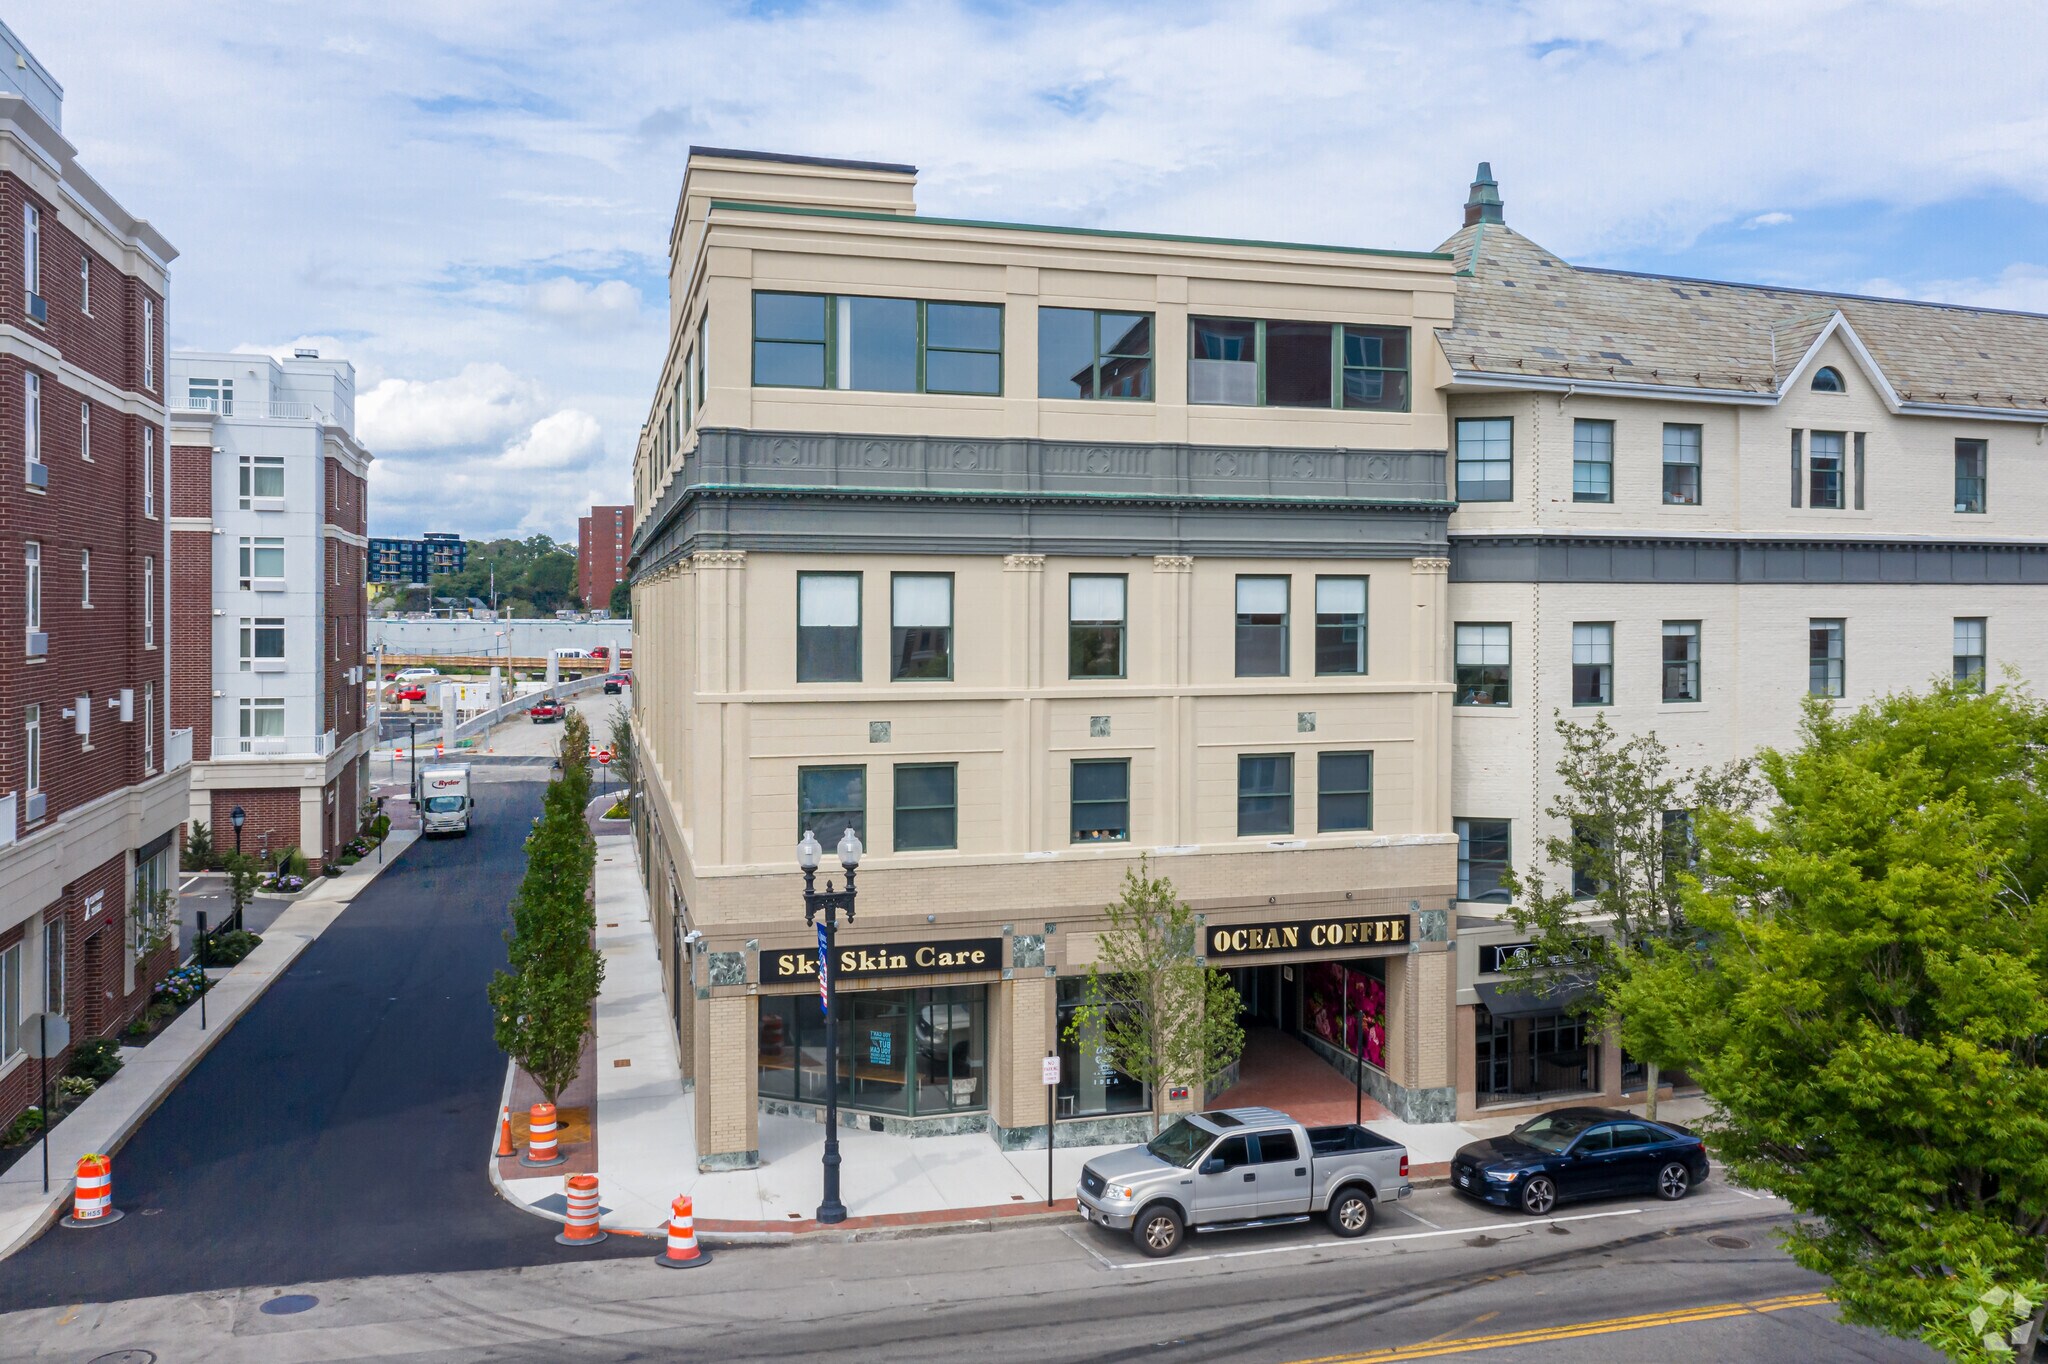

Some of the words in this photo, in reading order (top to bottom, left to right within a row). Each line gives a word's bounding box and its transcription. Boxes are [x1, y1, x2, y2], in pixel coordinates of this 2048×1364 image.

[438, 779, 461, 787] Ryder
[1213, 926, 1299, 952] OCEAN
[1310, 919, 1406, 946] COFFEE
[841, 949, 908, 972] Skin
[915, 946, 986, 968] Care
